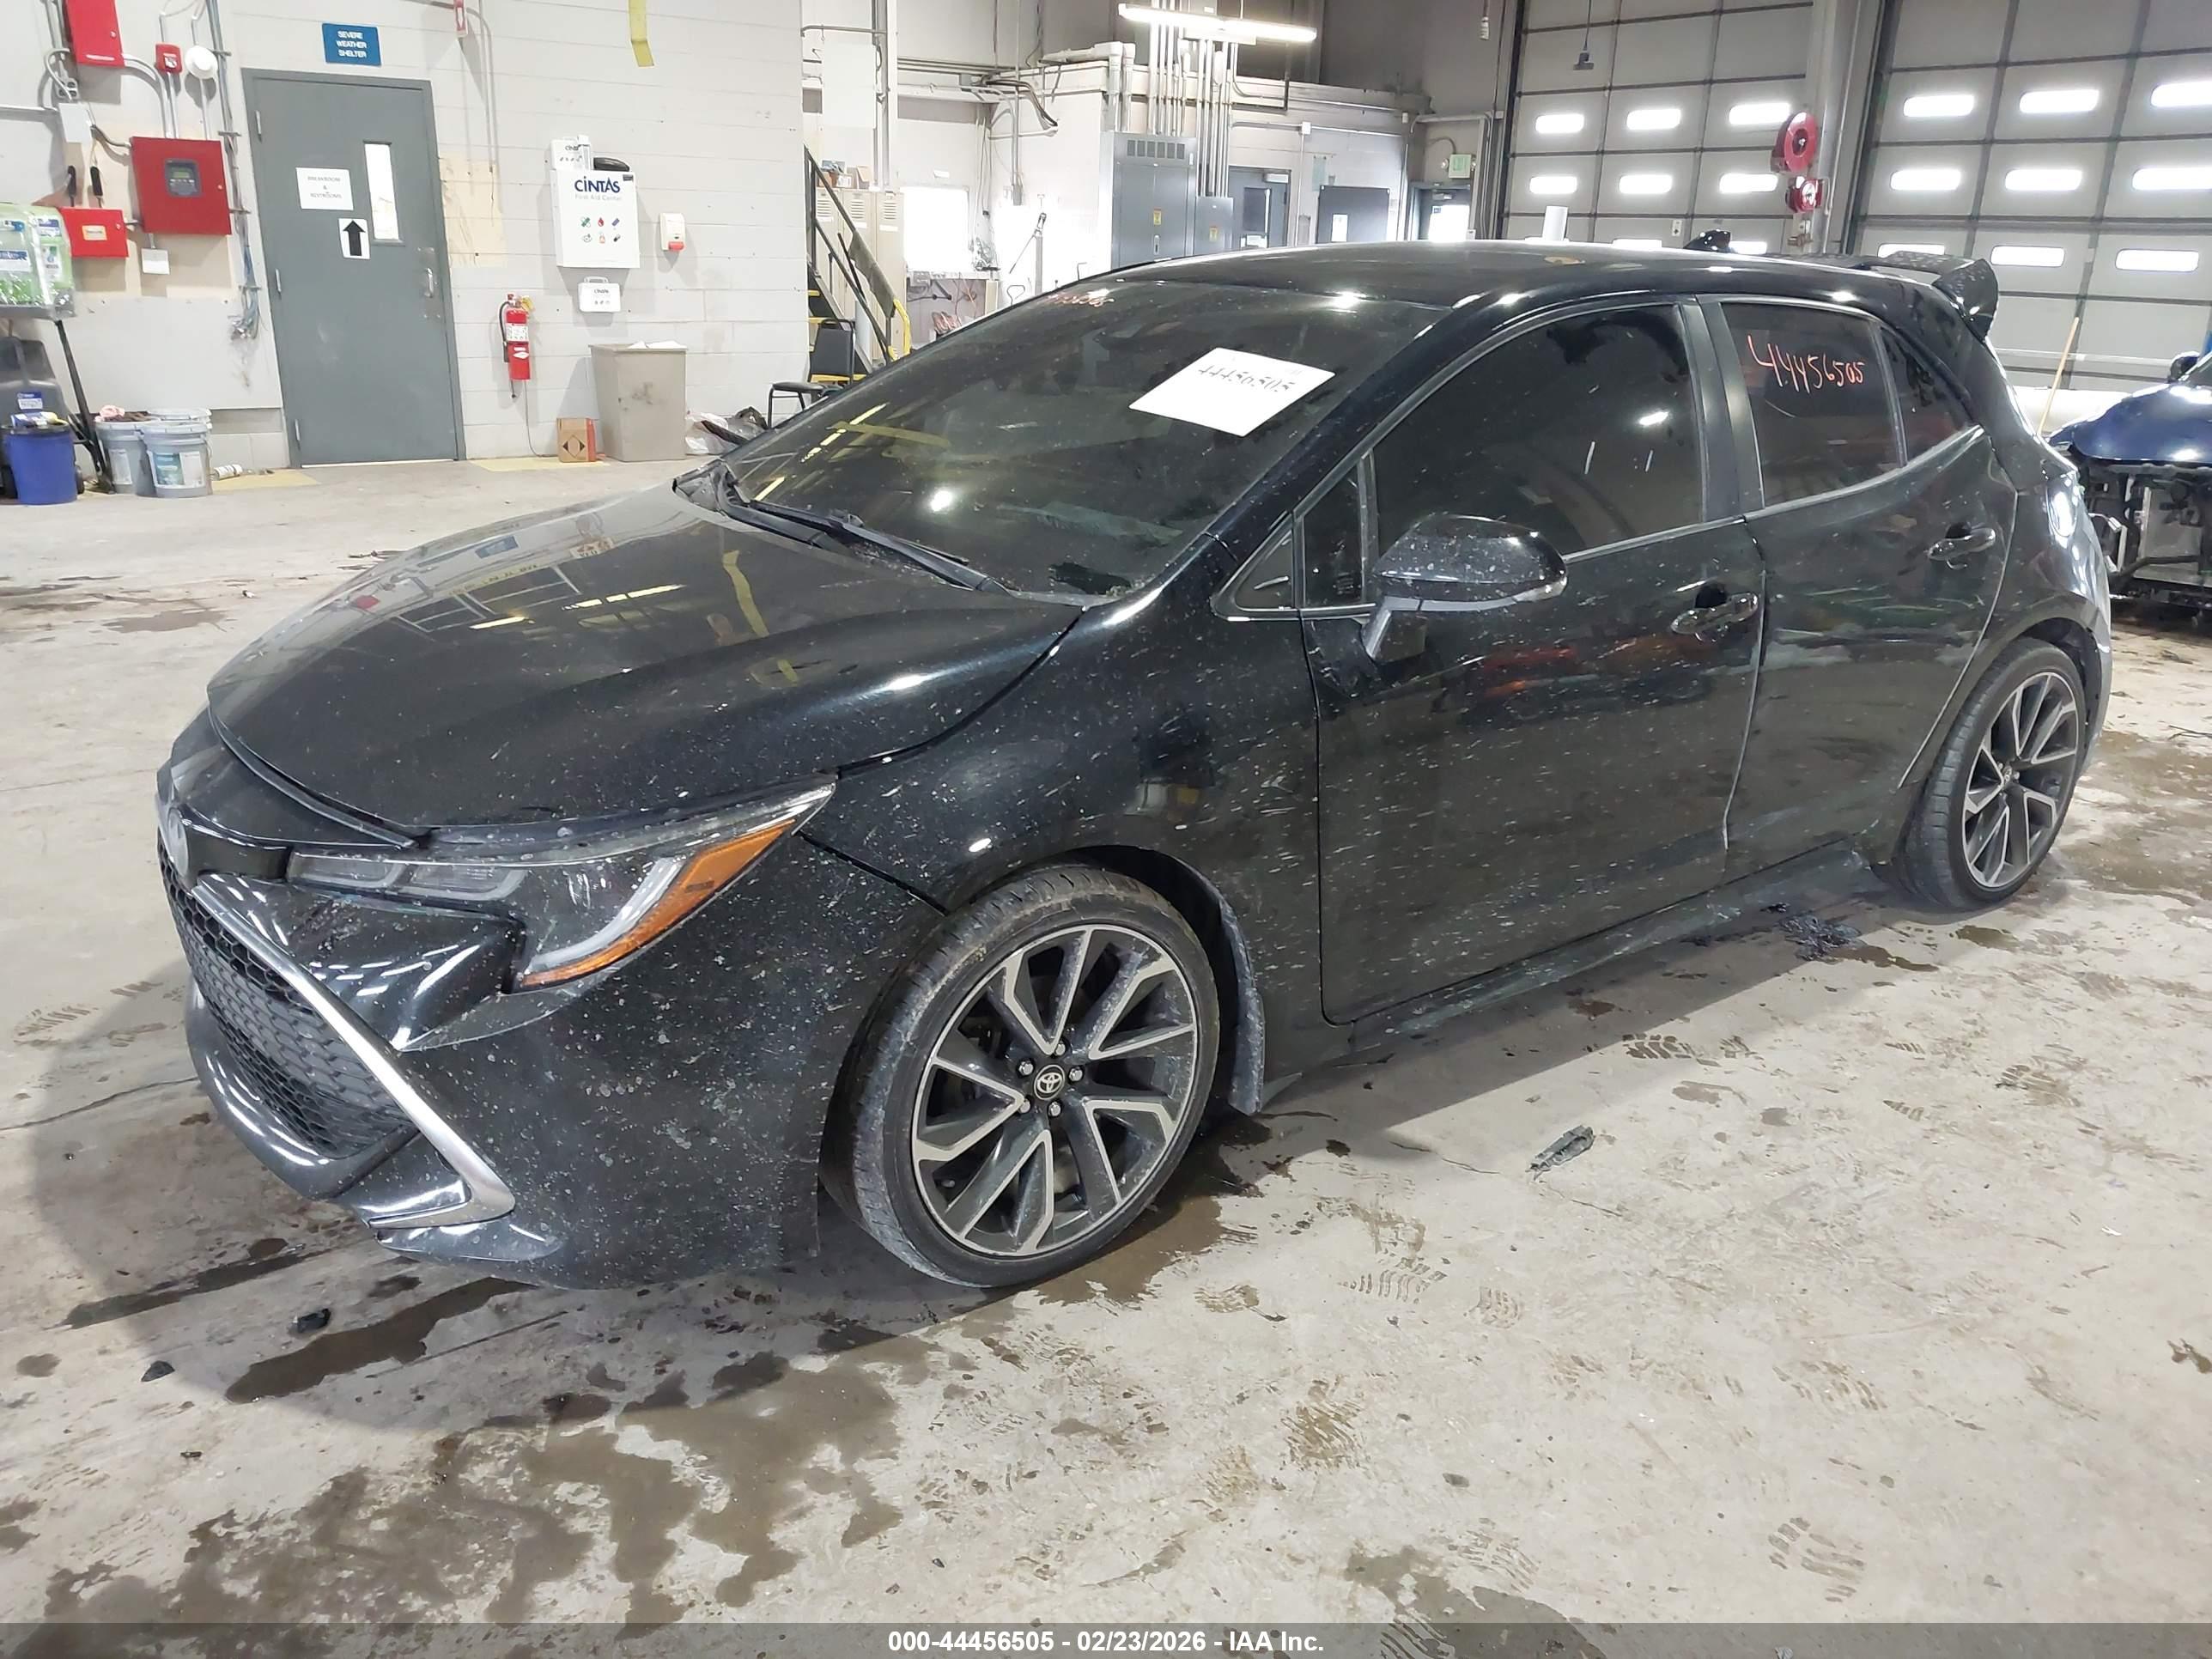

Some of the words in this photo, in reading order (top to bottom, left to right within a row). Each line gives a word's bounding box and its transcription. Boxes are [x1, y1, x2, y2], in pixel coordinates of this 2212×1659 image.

[337, 30, 363, 40] SEVERE
[336, 40, 368, 49] WEATHER
[337, 49, 368, 58] SHELTER
[574, 175, 621, 193] CINTAS
[1747, 334, 1866, 394] 44456505
